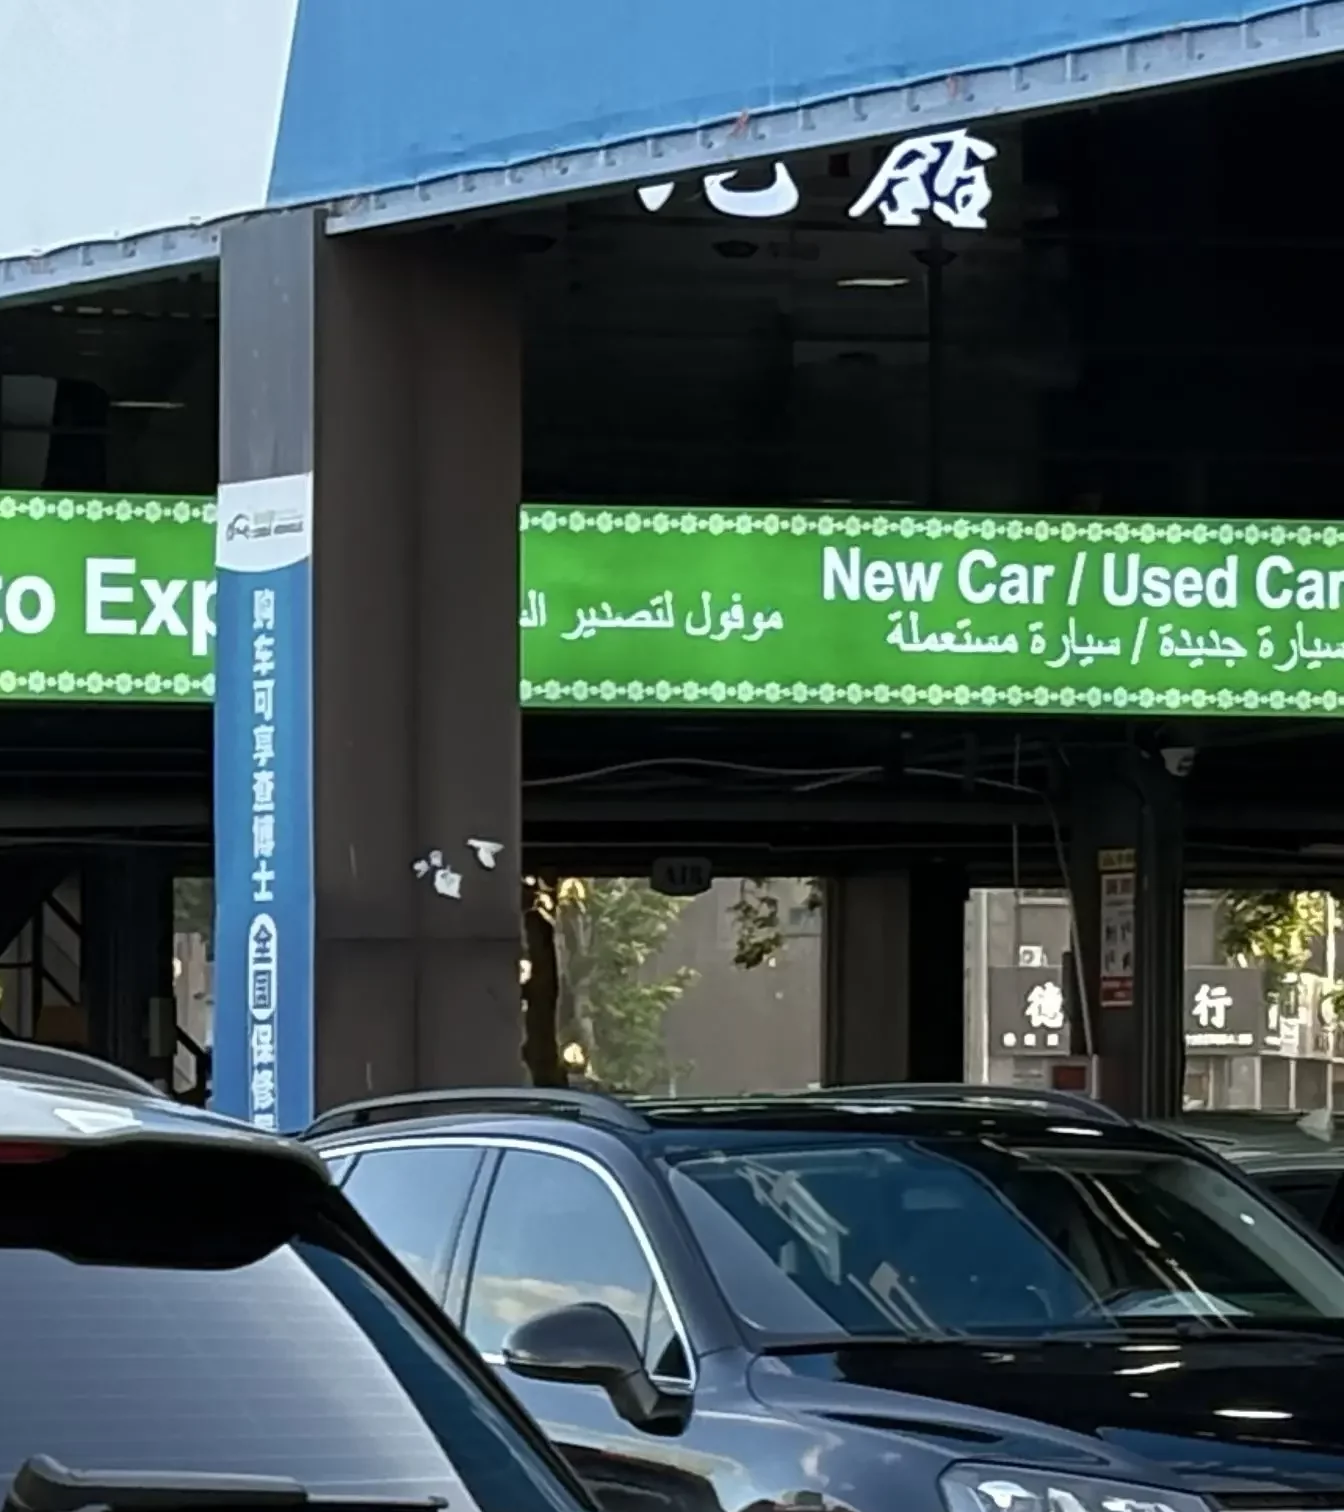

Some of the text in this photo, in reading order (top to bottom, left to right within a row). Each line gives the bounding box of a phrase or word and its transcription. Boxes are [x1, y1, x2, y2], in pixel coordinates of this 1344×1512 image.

[822, 546, 1344, 611] New Car / Used Car
[1192, 984, 1233, 1028] 行
